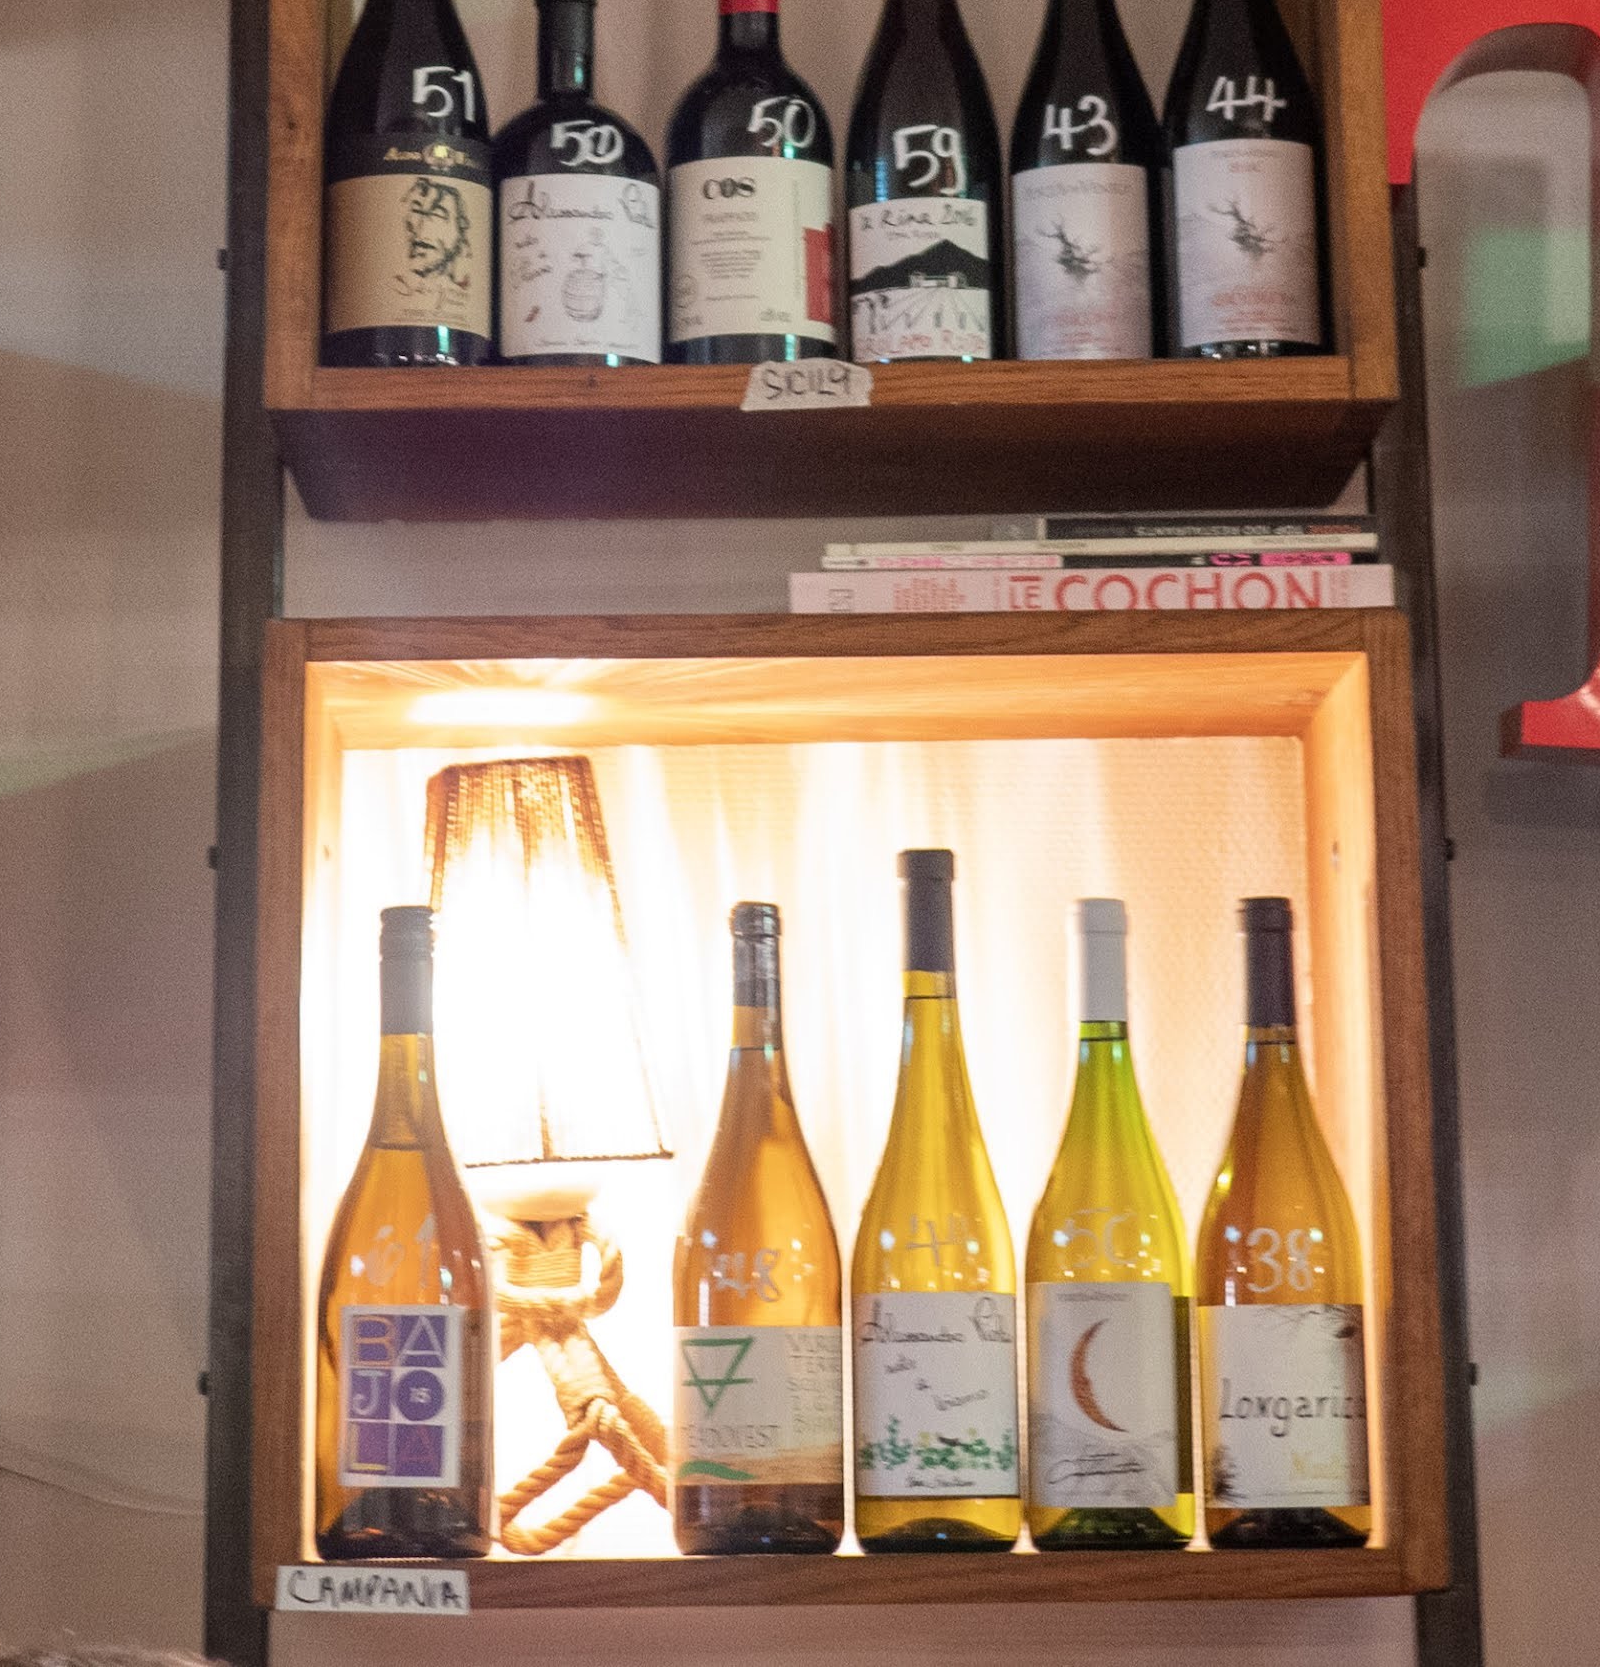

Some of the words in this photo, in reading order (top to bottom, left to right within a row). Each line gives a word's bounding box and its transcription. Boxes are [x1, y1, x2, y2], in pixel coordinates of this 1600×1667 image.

[412, 66, 476, 123] 51
[1206, 75, 1288, 123] 44
[550, 120, 625, 167] 50
[747, 96, 816, 148] 50
[1043, 95, 1118, 156] 43
[893, 125, 967, 196] 59
[703, 177, 756, 200] COS
[1008, 575, 1043, 610] LE
[1054, 572, 1321, 611] COCHON
[1246, 1227, 1313, 1295] 38
[288, 1571, 464, 1612] CAMPANIA
